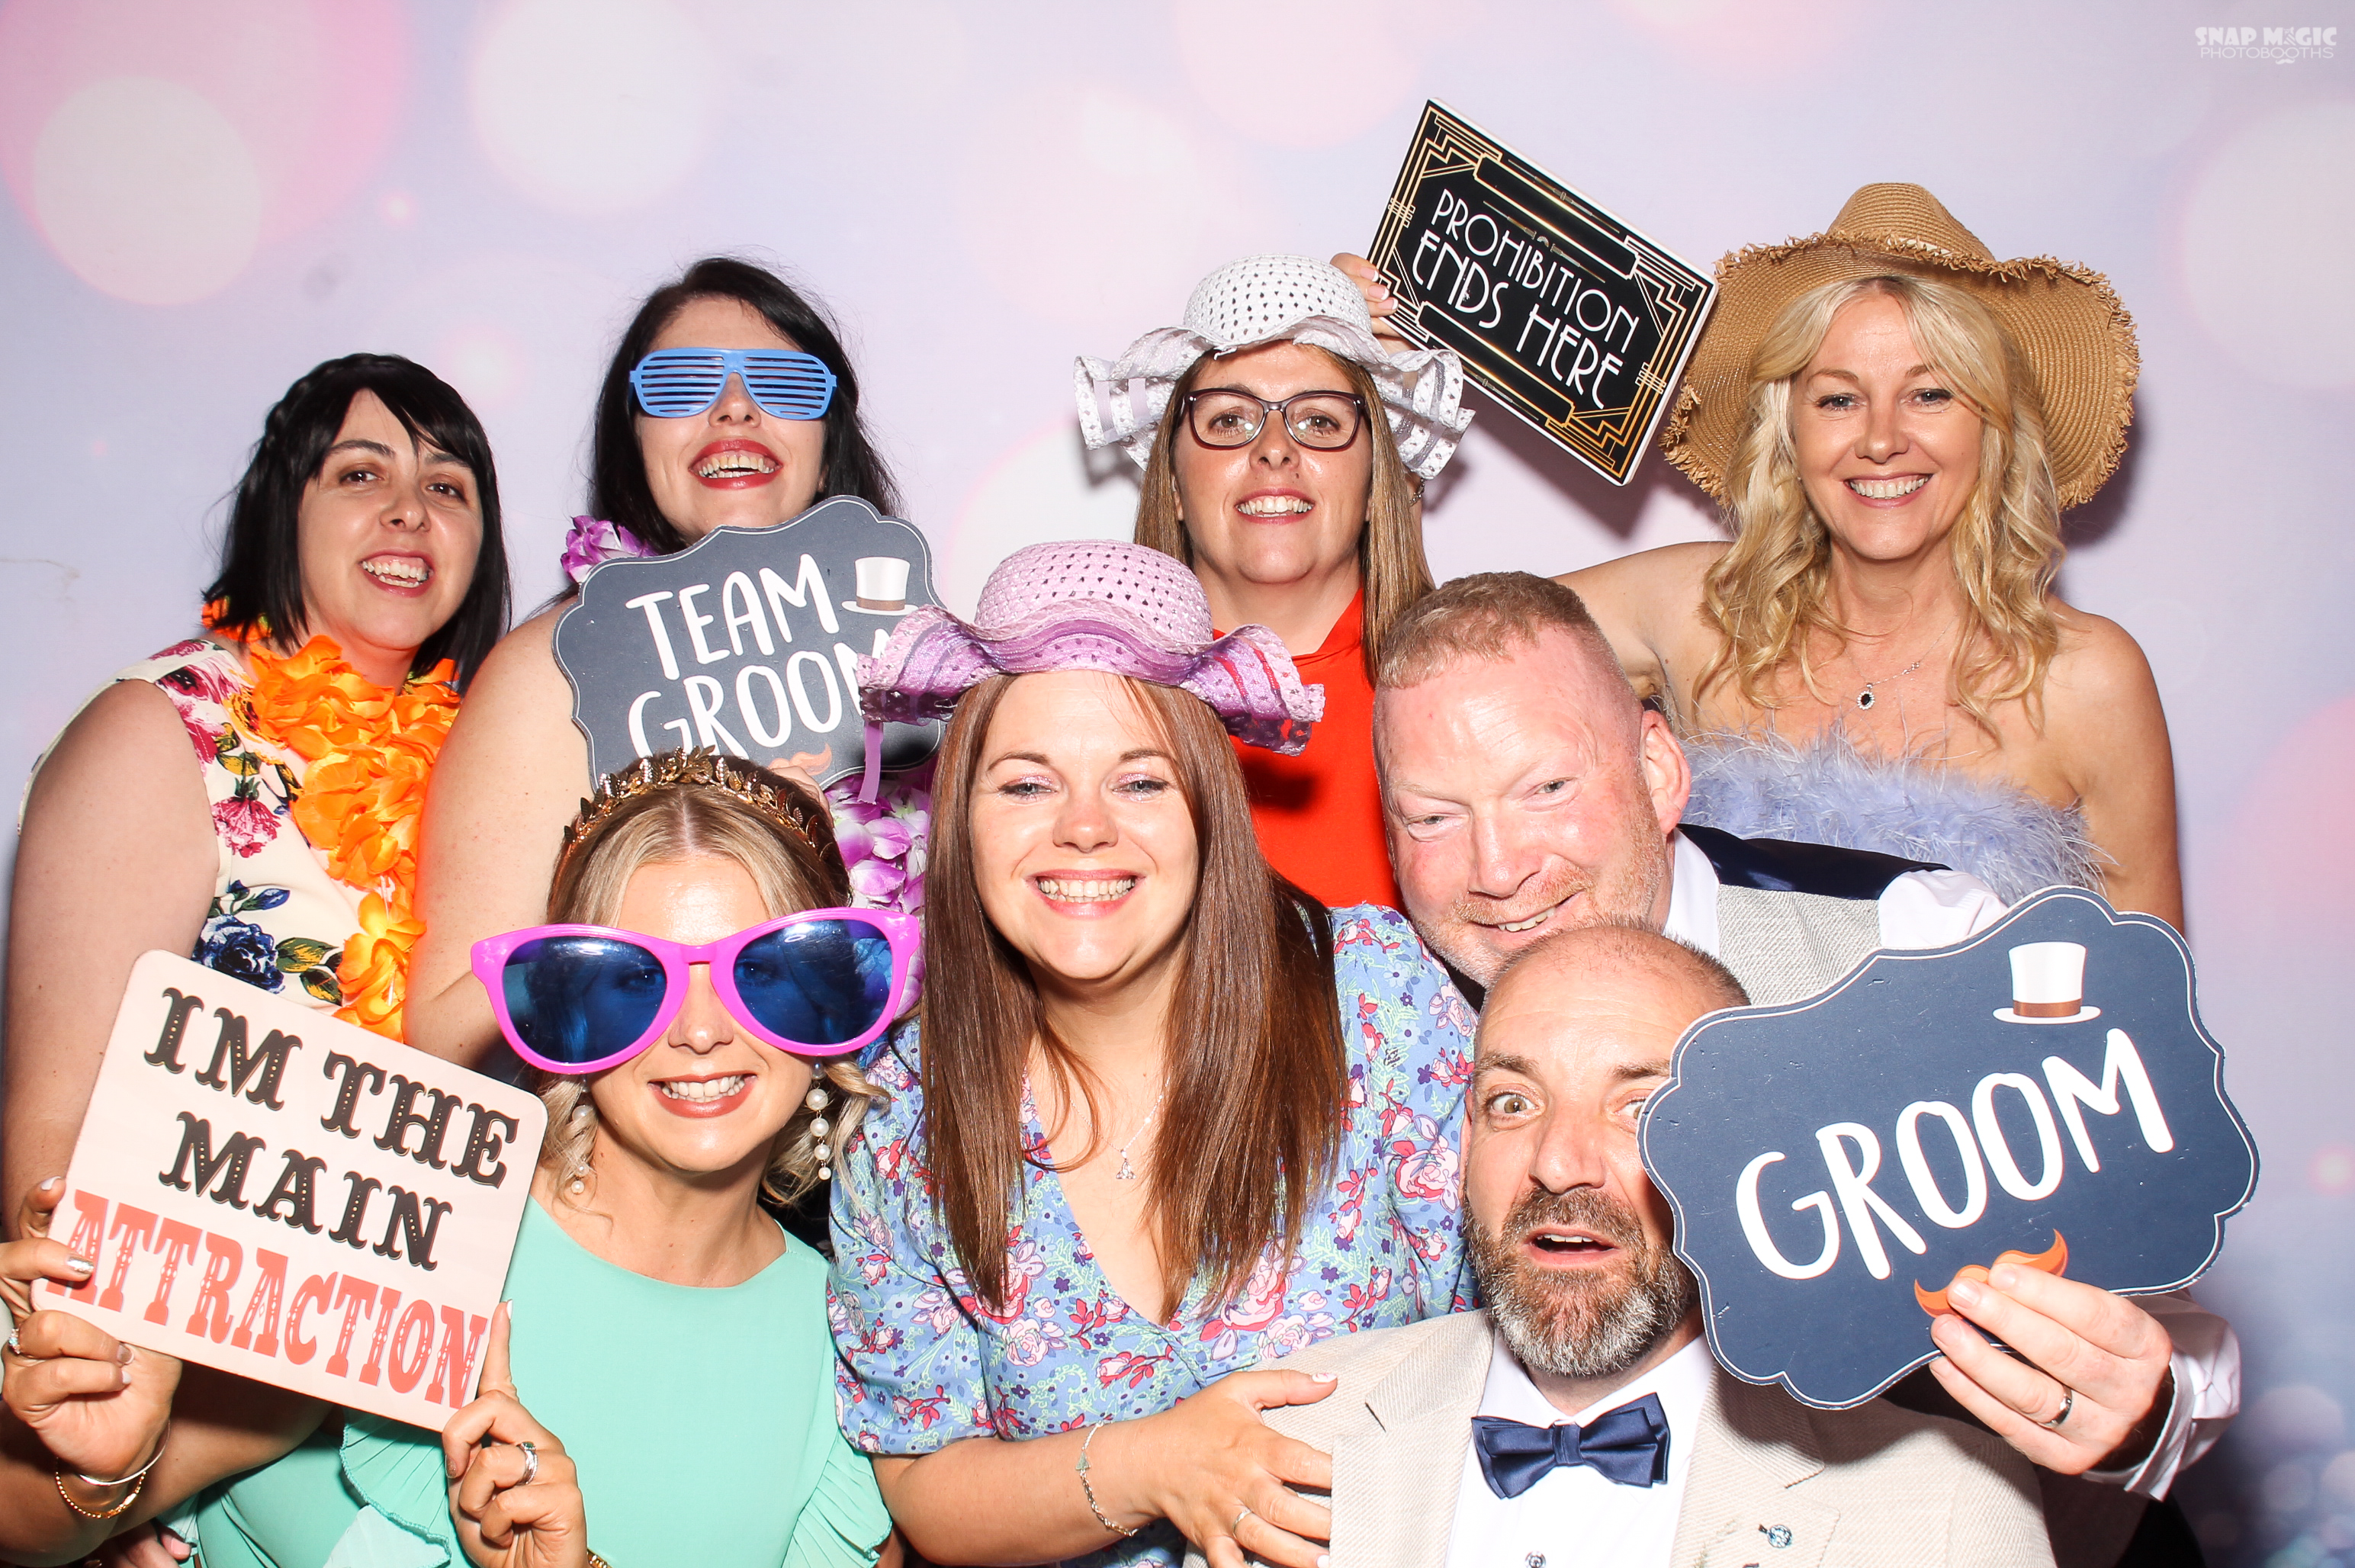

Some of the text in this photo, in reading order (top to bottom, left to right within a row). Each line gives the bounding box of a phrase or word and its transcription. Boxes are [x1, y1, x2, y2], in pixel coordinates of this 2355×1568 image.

[1412, 229, 1624, 410] ENDS HERE
[1430, 188, 1640, 355] PROHIBITION
[625, 553, 840, 681] TEAM
[143, 987, 520, 1190] IM THE
[1735, 1027, 2175, 1280] GROOM
[158, 1110, 454, 1272] MAIN
[45, 1188, 489, 1412] ATTRACTION
